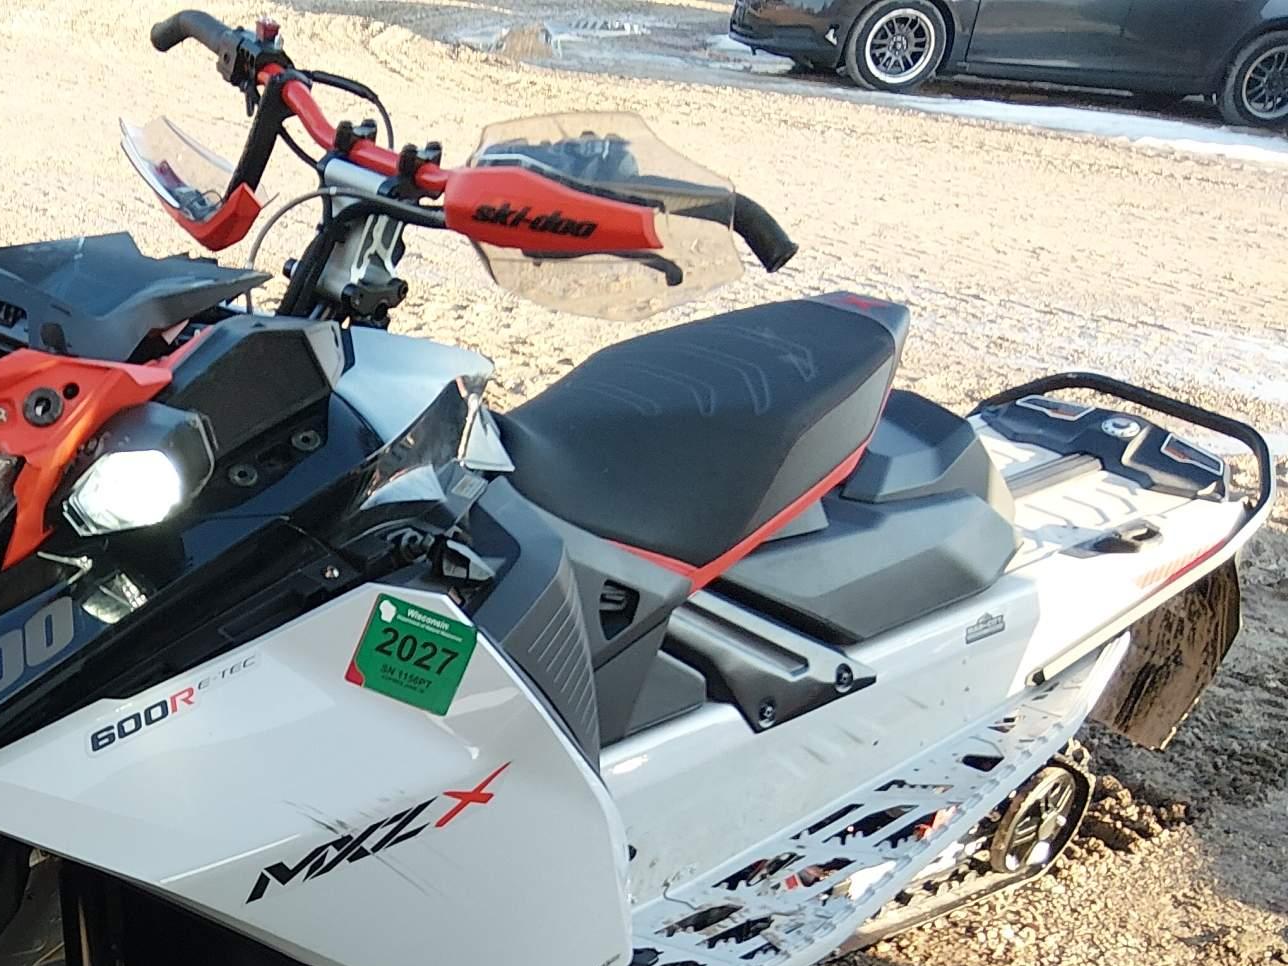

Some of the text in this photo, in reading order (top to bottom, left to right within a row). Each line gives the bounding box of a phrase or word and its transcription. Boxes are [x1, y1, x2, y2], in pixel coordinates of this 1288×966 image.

[472, 203, 598, 237] ski-doo
[407, 608, 450, 631] Wisconsin
[375, 628, 459, 675] 2027
[91, 655, 256, 752] 600R E-TEC
[245, 761, 512, 904] MXZ X
